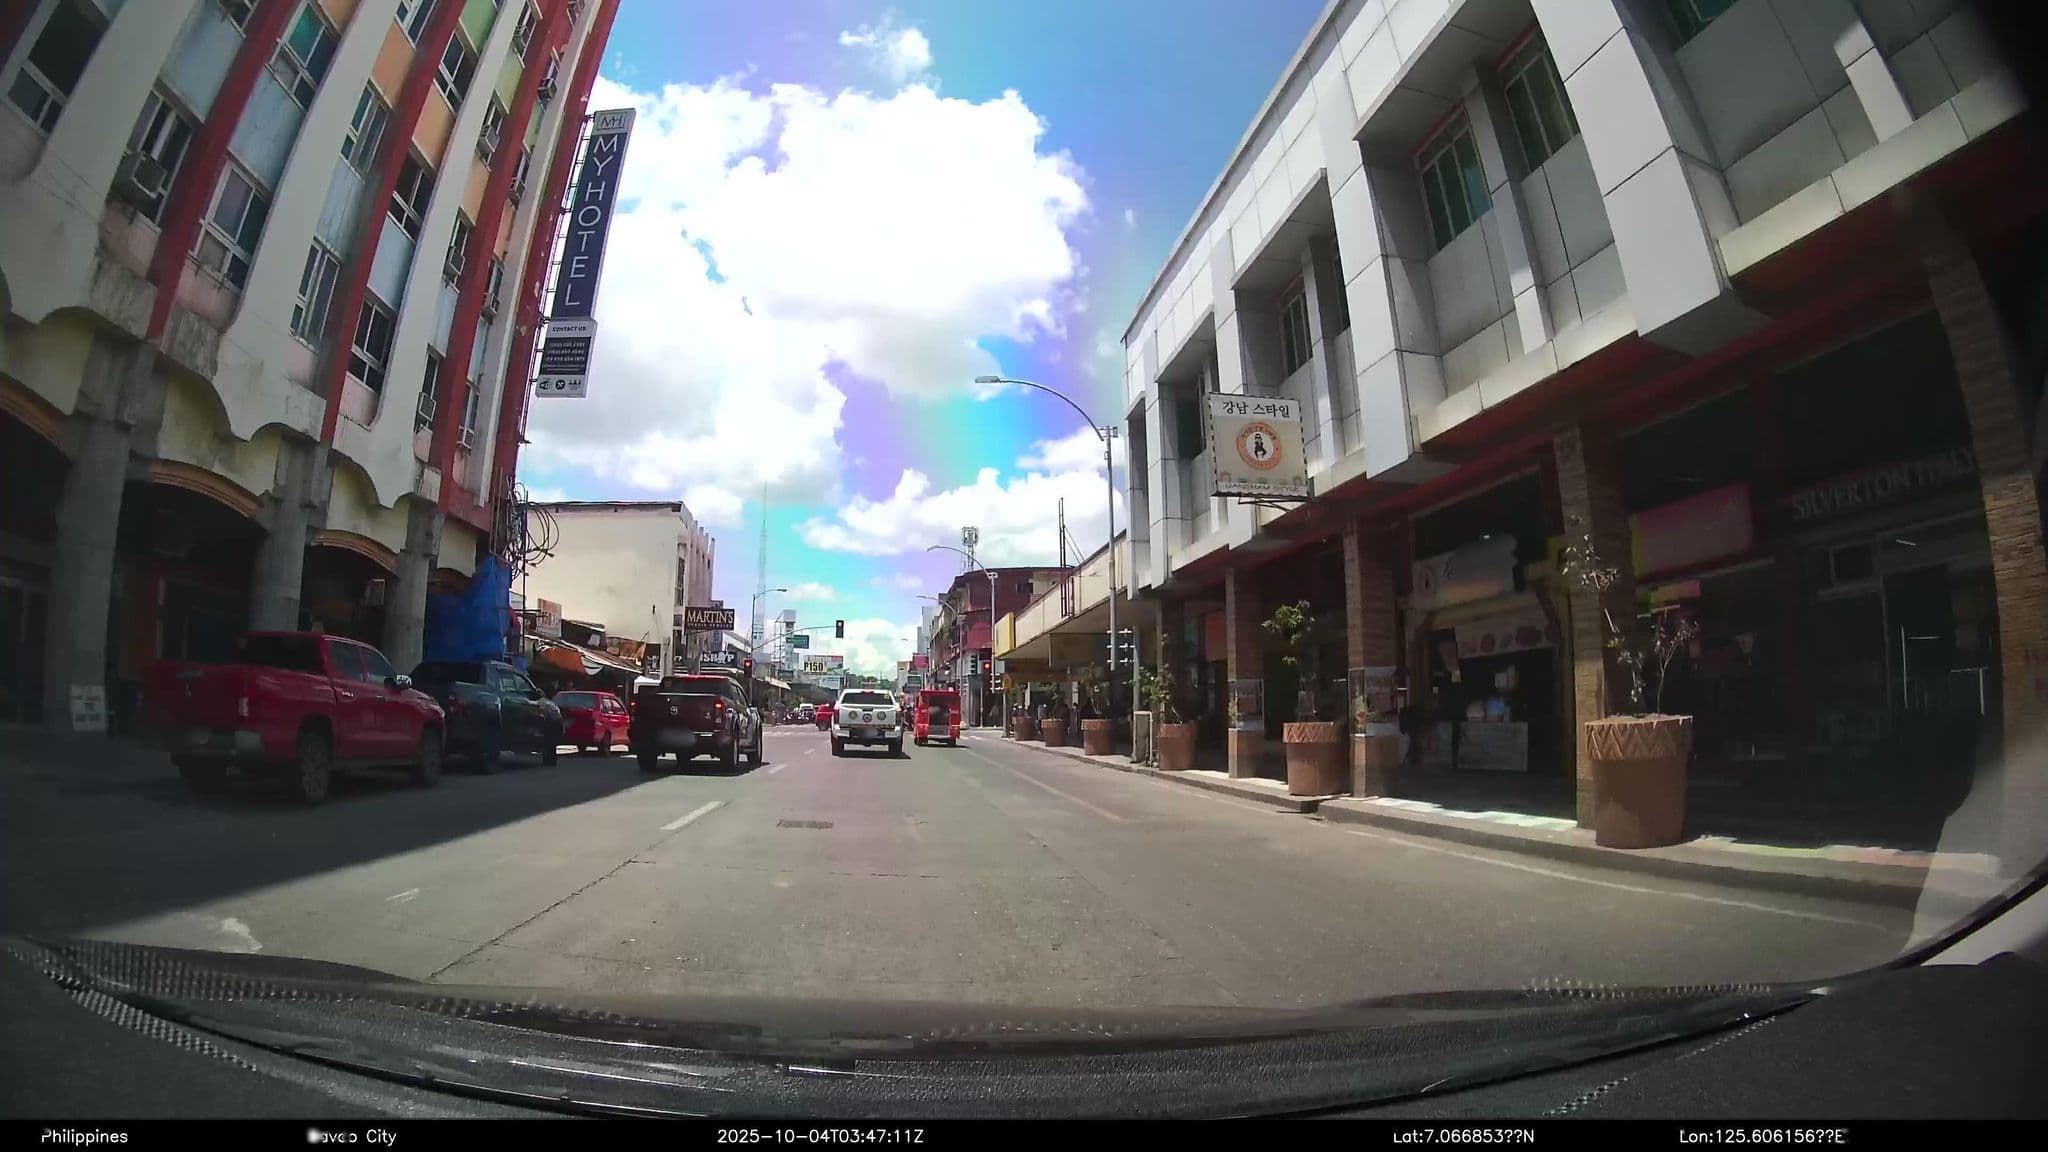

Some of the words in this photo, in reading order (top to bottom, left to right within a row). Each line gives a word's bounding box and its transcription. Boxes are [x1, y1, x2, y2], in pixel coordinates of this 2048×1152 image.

[565, 182, 606, 306] HOTEL
[1222, 400, 1248, 415] 강남
[1252, 403, 1290, 418] 스타일
[1791, 462, 1910, 521] SILVERTON
[687, 609, 733, 624] MARTIN'S
